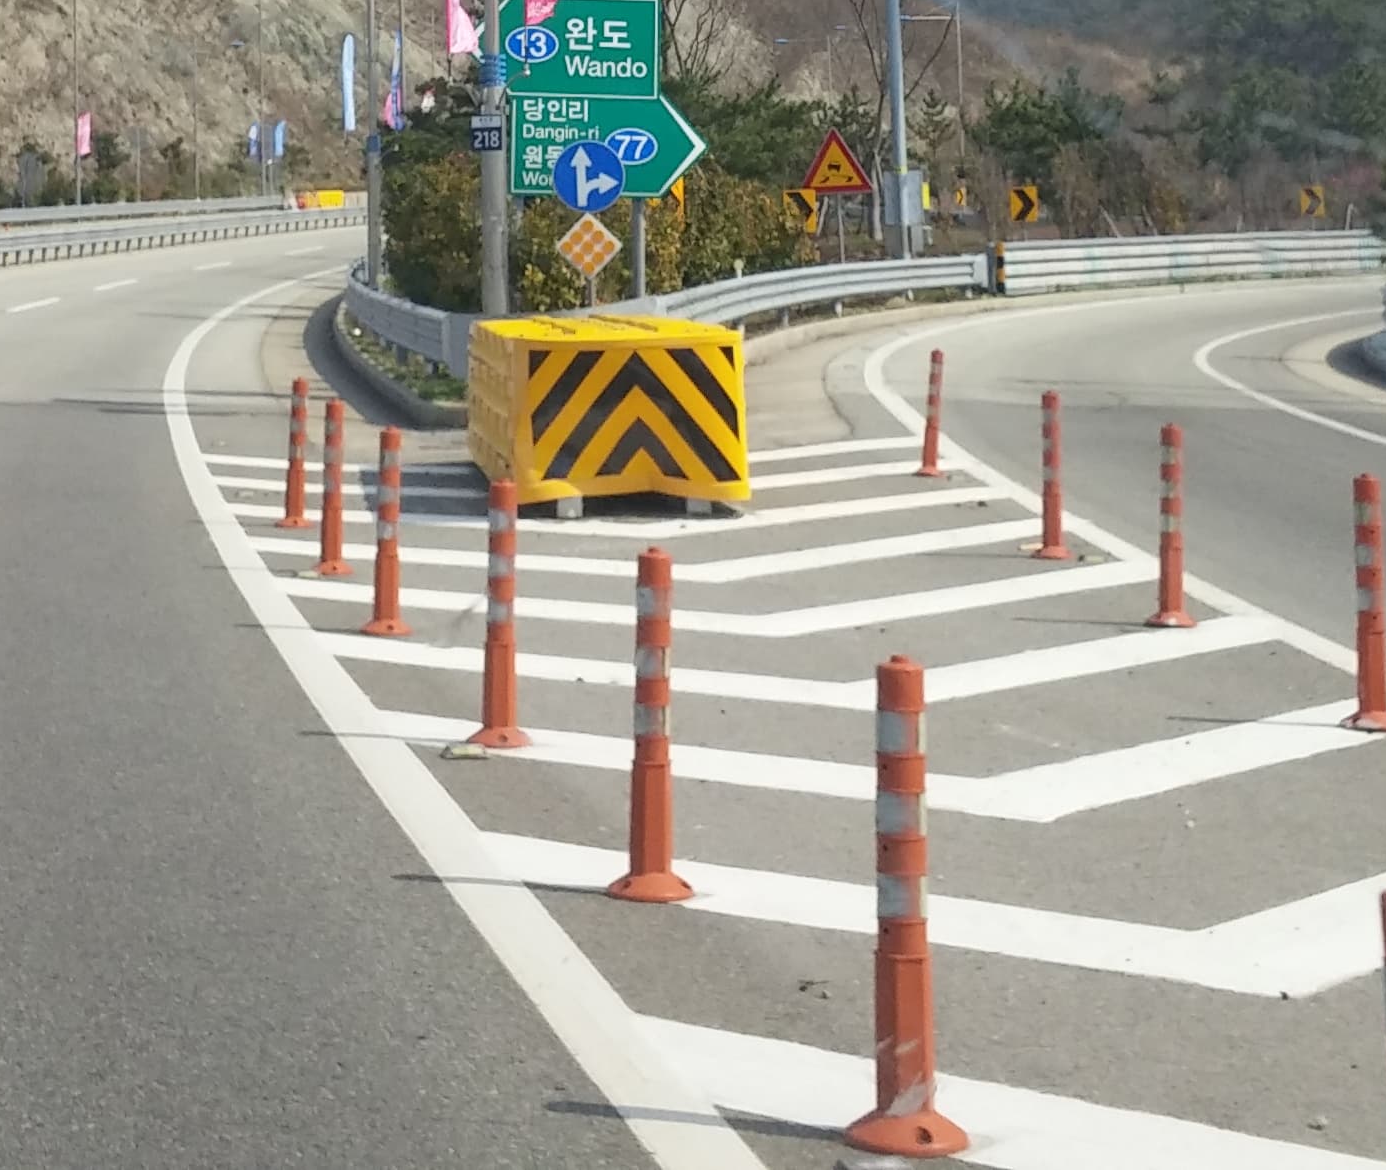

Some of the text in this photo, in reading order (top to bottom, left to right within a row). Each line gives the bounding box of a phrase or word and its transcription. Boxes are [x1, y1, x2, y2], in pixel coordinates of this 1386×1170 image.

[515, 31, 547, 58] 13
[565, 16, 631, 51] 완도
[564, 55, 647, 78] Wando
[523, 97, 589, 123] 당인리
[473, 130, 500, 148] 218
[522, 123, 599, 143] Dangin-ri
[614, 134, 648, 159] 77
